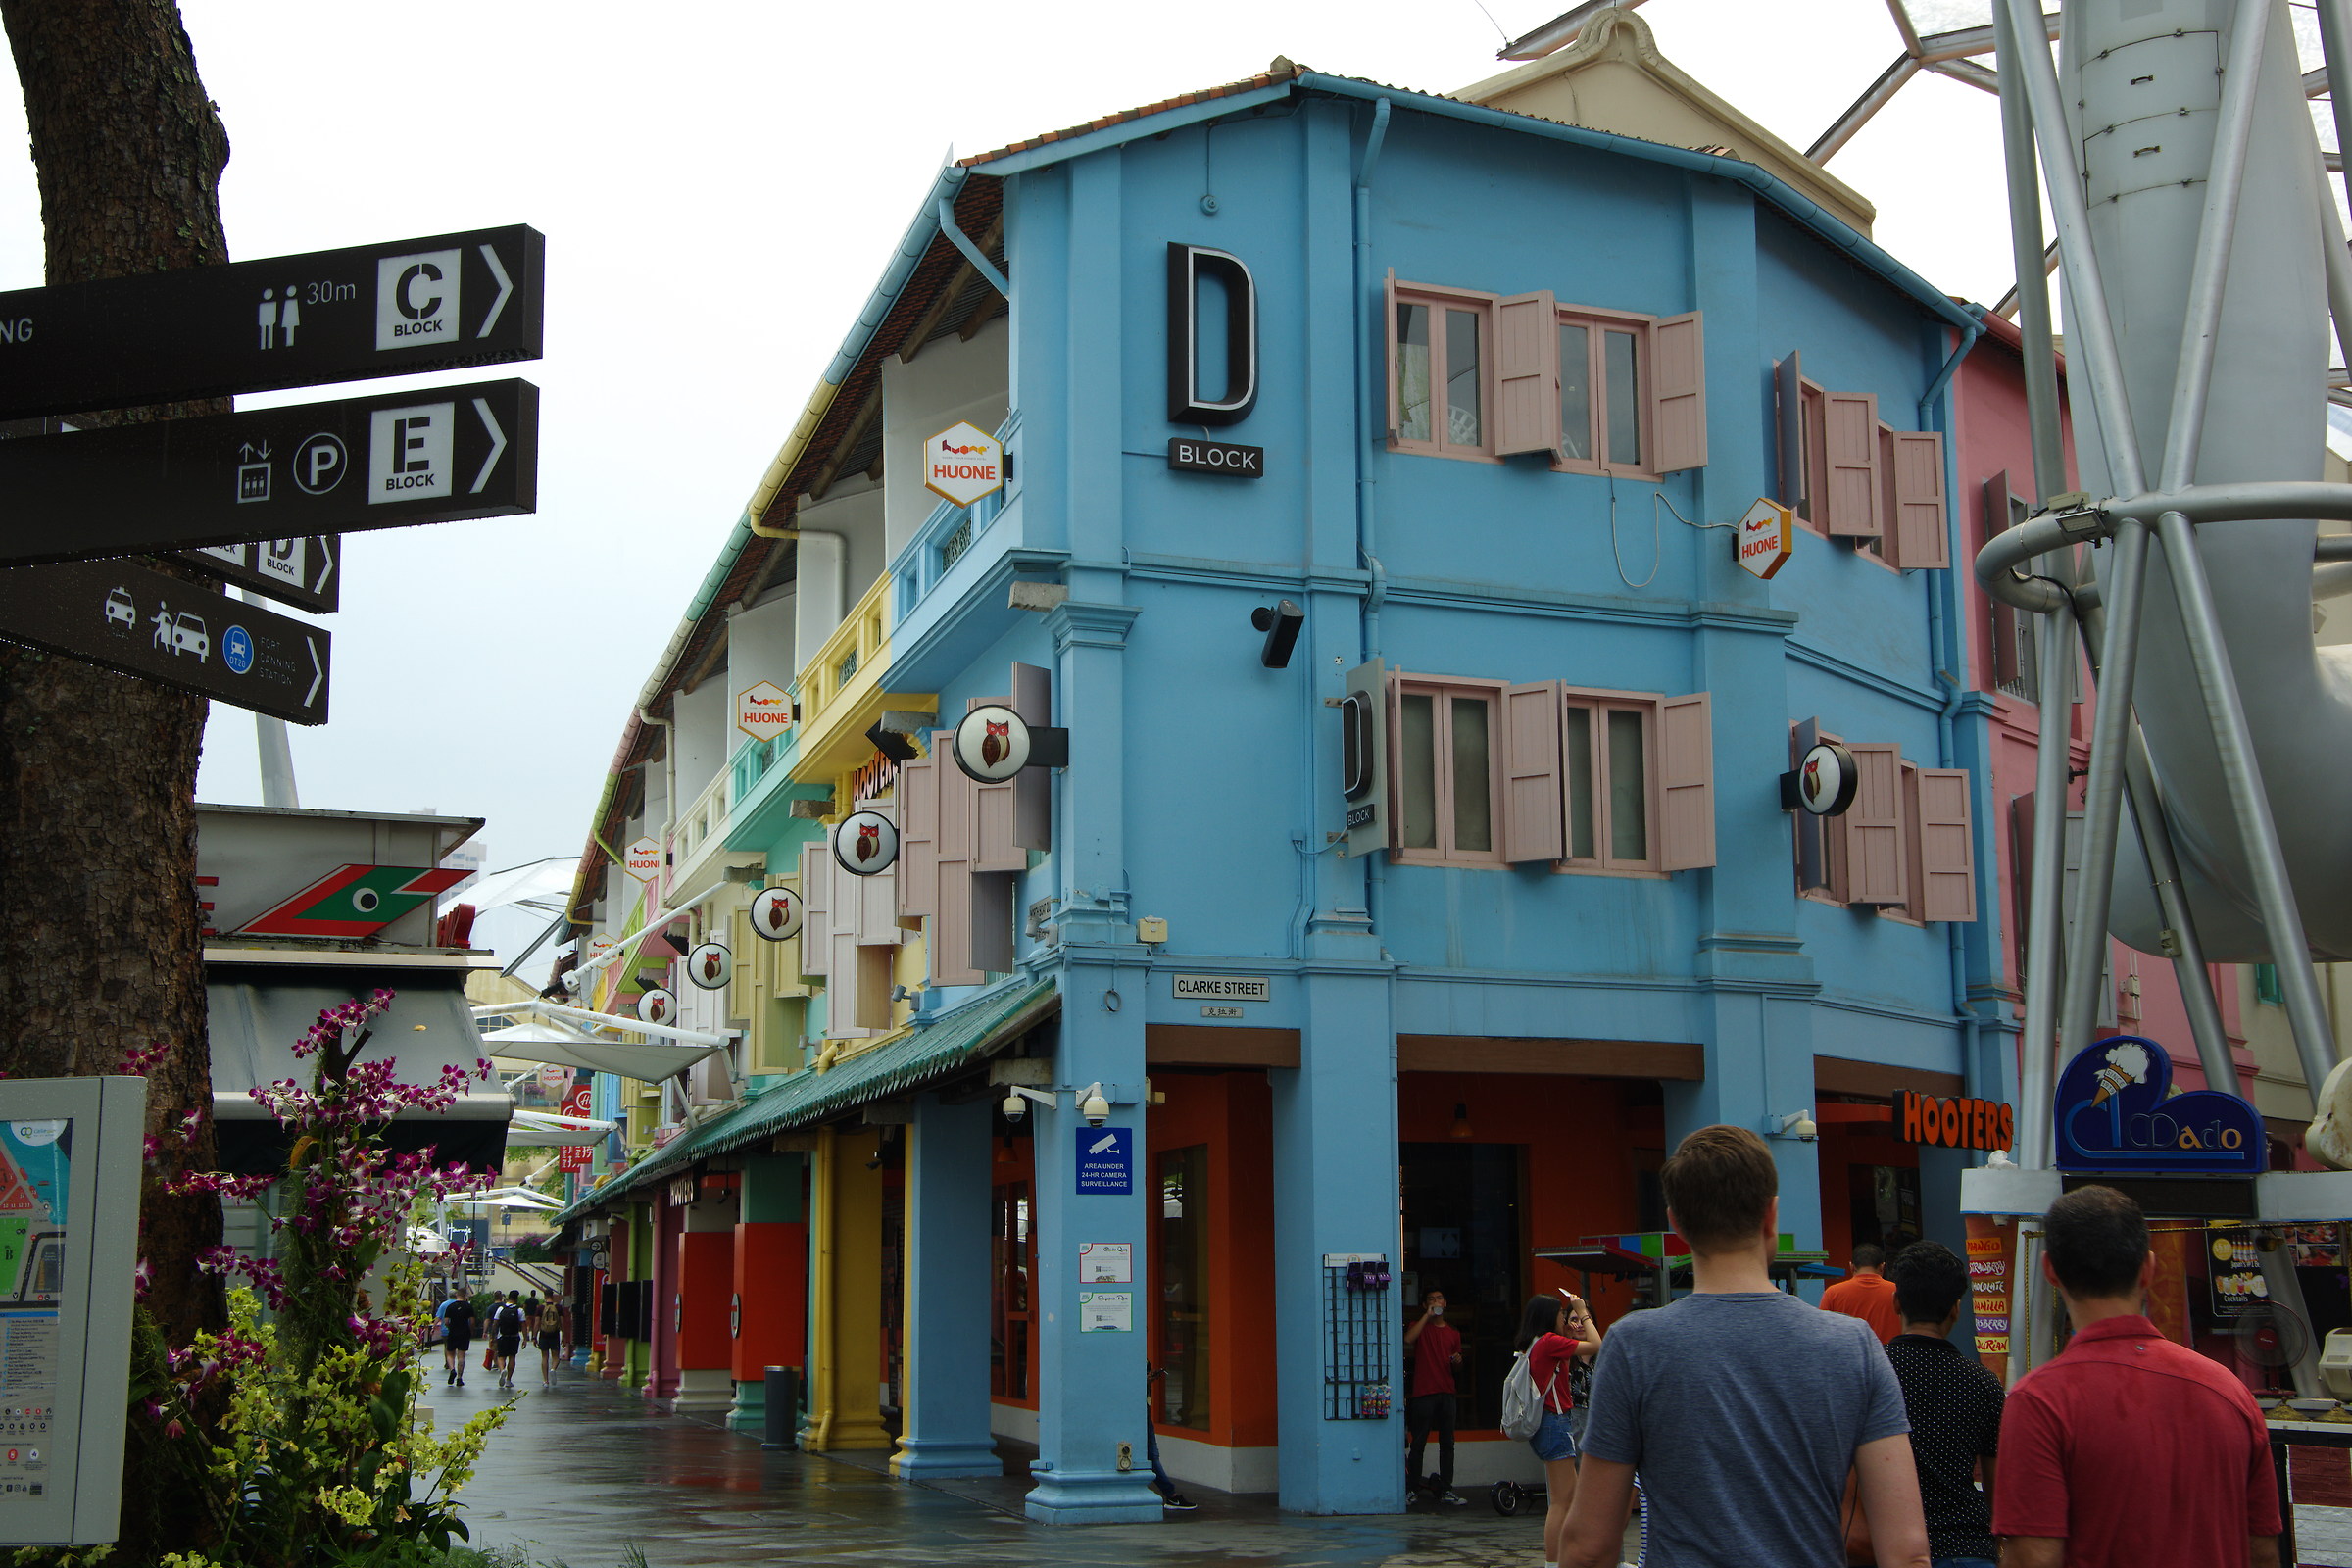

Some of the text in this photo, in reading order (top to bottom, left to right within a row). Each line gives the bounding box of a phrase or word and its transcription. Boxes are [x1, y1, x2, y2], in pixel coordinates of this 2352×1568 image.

[307, 280, 357, 306] 30m
[396, 263, 443, 320] C
[394, 319, 443, 337] BLOCK
[1172, 242, 1259, 424] D
[393, 416, 431, 474] E
[1179, 444, 1256, 470] BLOCK
[934, 464, 996, 480] HUONE
[386, 473, 435, 491] BLOCK
[1741, 535, 1779, 560] HUONE
[267, 557, 295, 576] BLOCK
[229, 656, 247, 668] DT20
[259, 667, 292, 685] STATION
[744, 712, 789, 724] HUONE
[1348, 807, 1370, 826] BLOCK
[1178, 979, 1265, 996] CLARKE STREET
[1904, 1090, 2014, 1153] HOOTERS
[1966, 1239, 2001, 1252] MANGO
[1972, 1280, 2005, 1294] HOCOLATE
